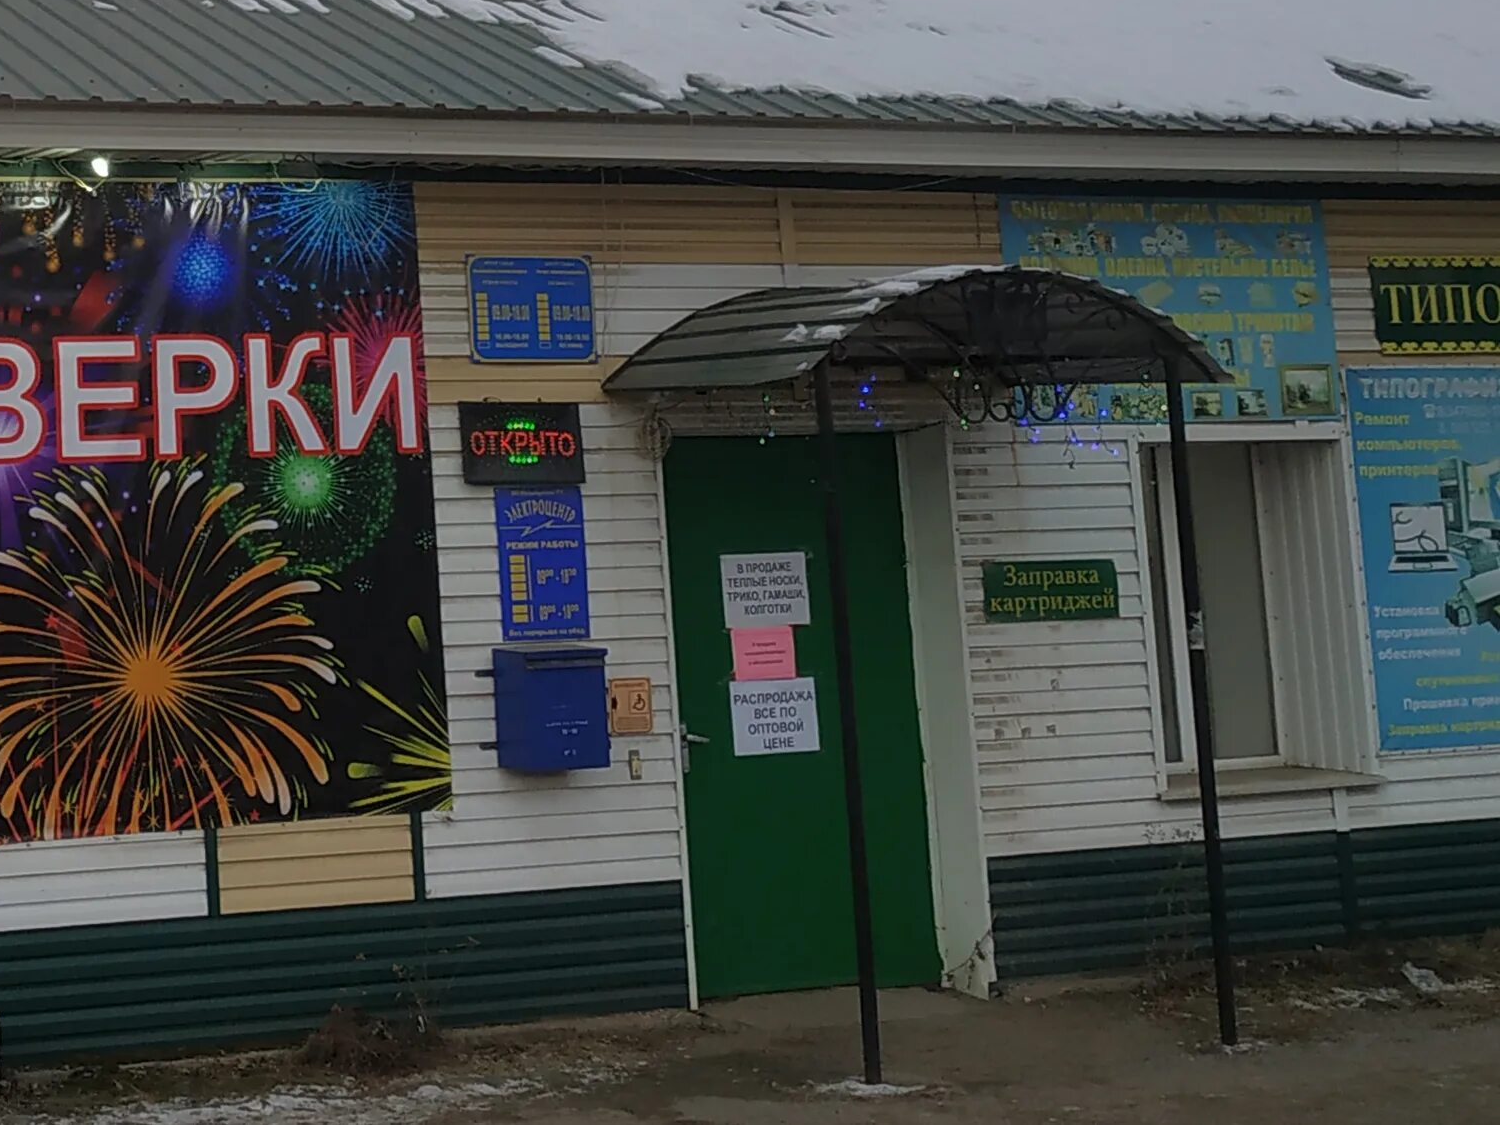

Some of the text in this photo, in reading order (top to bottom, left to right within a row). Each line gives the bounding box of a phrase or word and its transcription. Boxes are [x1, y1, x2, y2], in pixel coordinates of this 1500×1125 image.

[1360, 377, 1500, 399] ТИПОГРАФИ
[1354, 411, 1410, 426] Ремонт
[470, 430, 576, 457] ОТКРЫТО
[504, 499, 576, 523] ЭЛЕКТРОЦЕНТР
[540, 539, 580, 549] РАБОТЫ
[737, 562, 792, 574] В ПРОДАЖЕ
[728, 575, 804, 588] ТЕПЛЫЕ НОСКИ,
[1003, 565, 1100, 591] Заправка
[728, 589, 806, 602] ТРИКО, ГАМАШИ,
[744, 604, 793, 616] КОЛГОТКИ
[990, 588, 1116, 618] картриджей
[733, 691, 813, 705] РАСПРОДАЖА
[754, 706, 797, 719] ВСЕ ПО
[748, 718, 804, 735] ОПТОВОЙ
[763, 736, 795, 750] ЦЕНЕ
